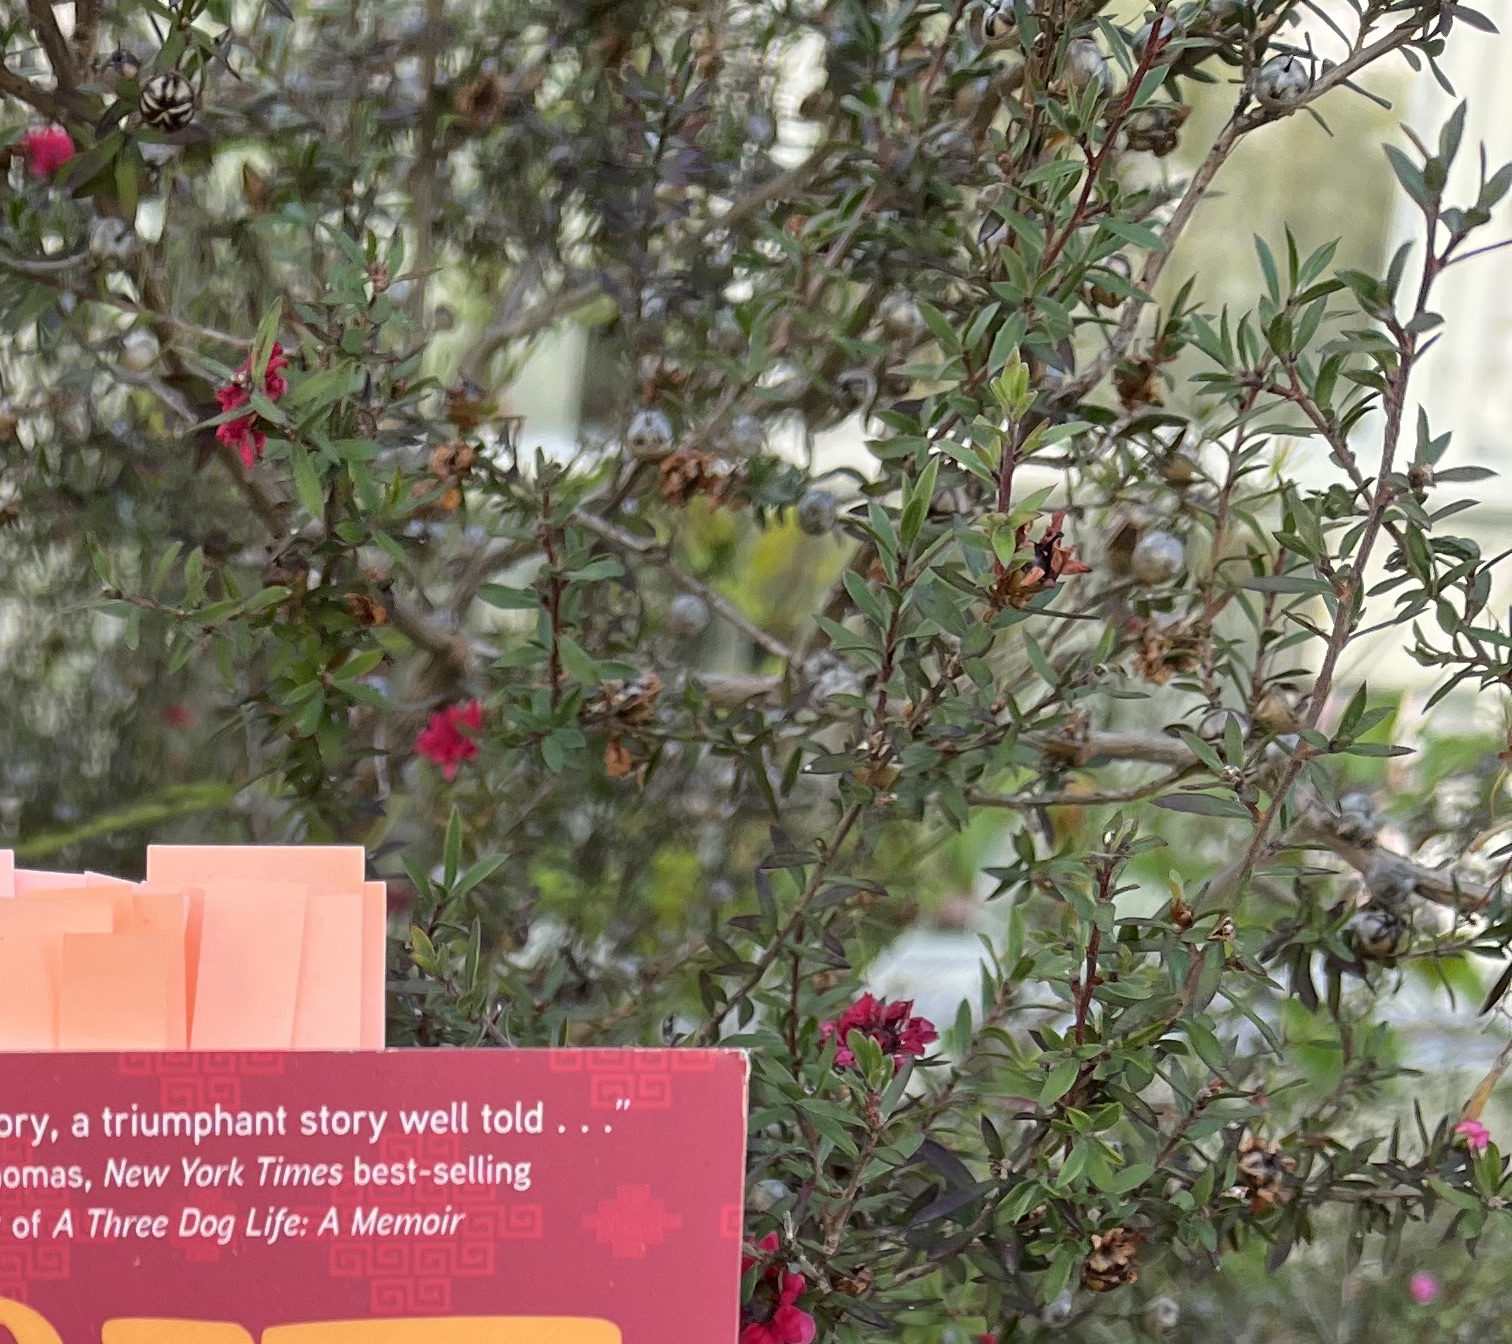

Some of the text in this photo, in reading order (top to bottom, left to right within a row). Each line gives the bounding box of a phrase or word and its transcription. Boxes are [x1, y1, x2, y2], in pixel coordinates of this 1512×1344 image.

[71, 1112, 90, 1138] a
[101, 1102, 287, 1146] triumphant
[300, 1105, 388, 1144] story
[399, 1101, 469, 1135] well
[480, 1100, 544, 1134] told
[103, 1158, 171, 1188] New
[181, 1157, 244, 1187] York
[257, 1155, 343, 1187] Times
[353, 1154, 532, 1192] best-selling
[12, 1209, 41, 1239] of
[52, 1208, 74, 1239] A
[87, 1207, 169, 1238] Three
[178, 1207, 236, 1245] Dog
[245, 1206, 309, 1245] Life:
[317, 1206, 339, 1236] A
[351, 1204, 466, 1236] Memoir
